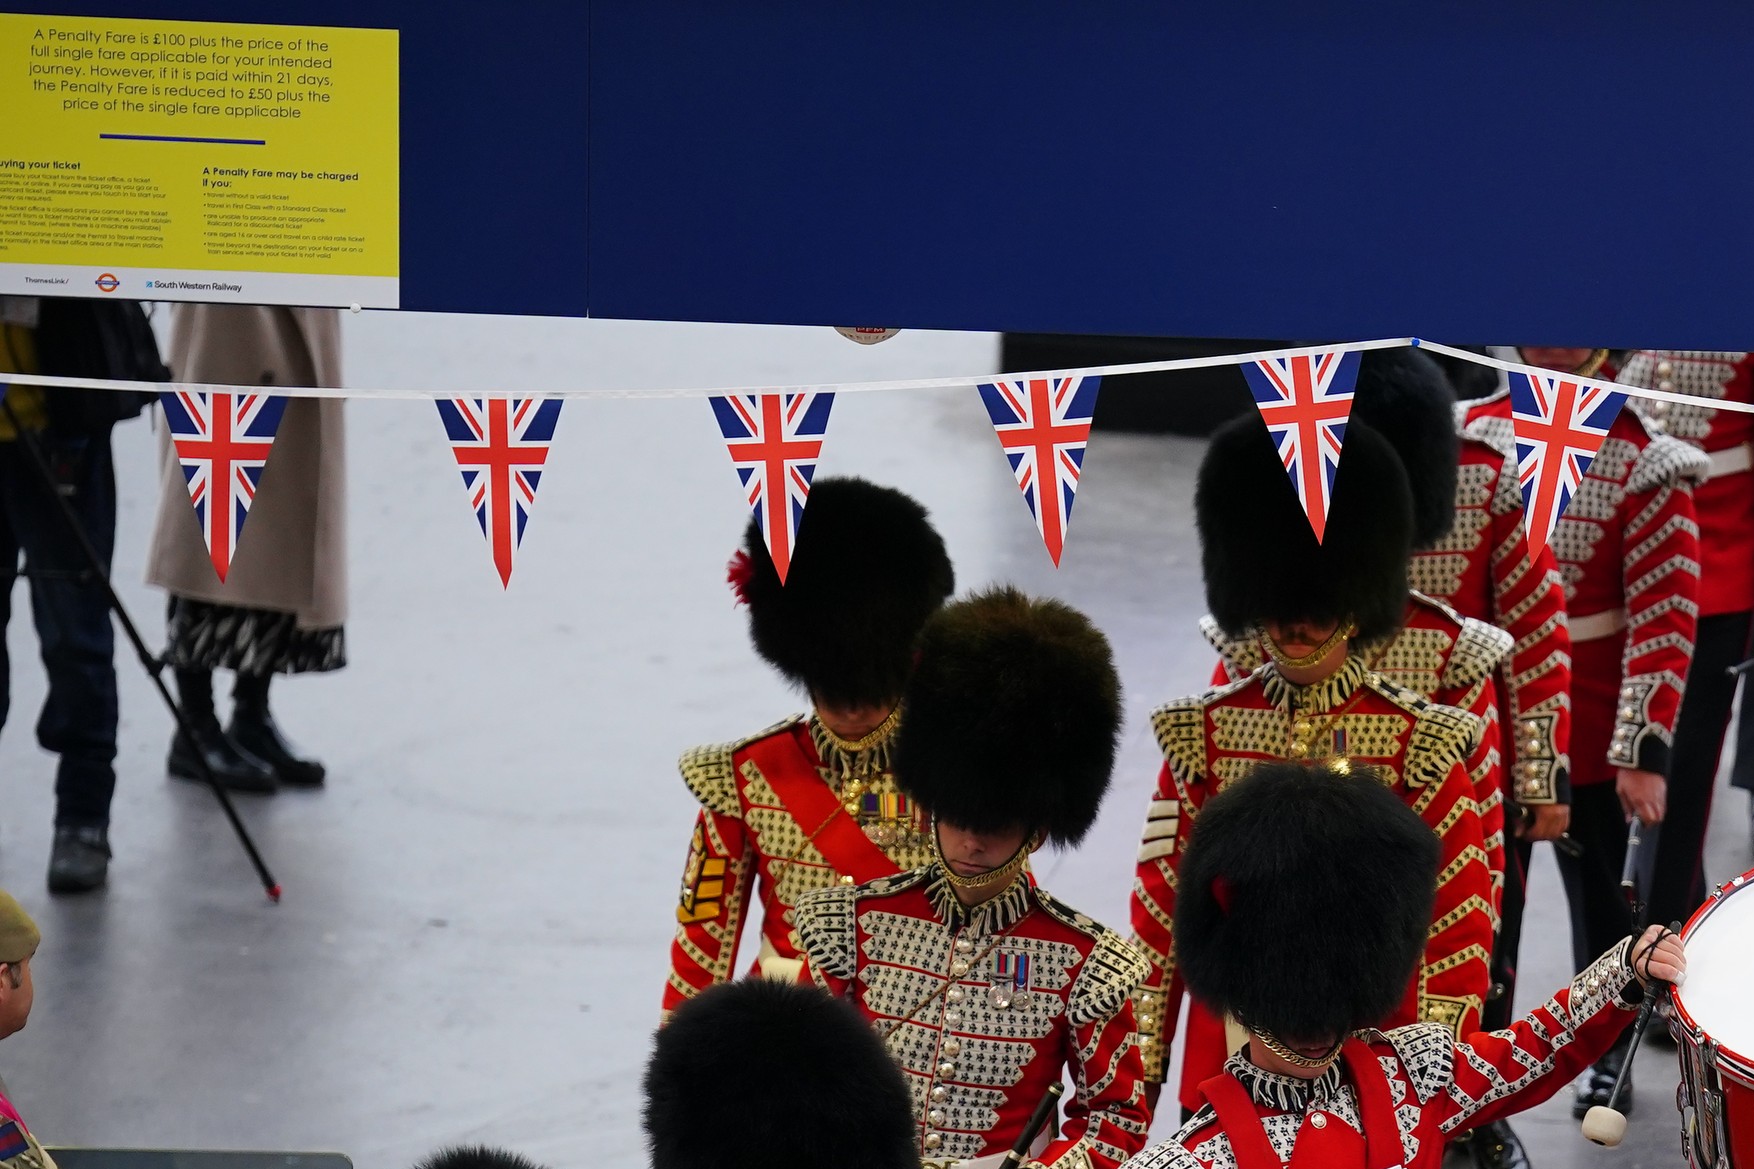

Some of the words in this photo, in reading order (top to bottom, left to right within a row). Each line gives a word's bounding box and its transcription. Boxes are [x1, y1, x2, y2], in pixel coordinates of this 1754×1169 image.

[33, 28, 45, 41] A
[50, 29, 101, 46] Penalty
[106, 31, 136, 44] Fare
[140, 32, 149, 45] is
[152, 33, 186, 46] £100
[189, 34, 217, 50] plus
[221, 36, 243, 48] the
[248, 37, 284, 53] price
[288, 38, 302, 51] of
[306, 39, 328, 52] the
[30, 45, 50, 58] full
[54, 46, 93, 62] single
[98, 48, 126, 60] fare
[130, 49, 207, 67] applicable
[211, 52, 229, 64] for
[233, 56, 264, 69] your
[268, 54, 332, 69] intended
[28, 62, 86, 79] journey.
[90, 64, 156, 80] However,
[159, 67, 168, 79] if
[171, 68, 179, 80] it
[183, 68, 192, 80] is
[195, 68, 228, 84] paid
[232, 70, 273, 83] within
[277, 72, 290, 84] 21
[296, 72, 333, 88] days,
[33, 79, 56, 92] the
[60, 80, 113, 97] Penalty
[117, 82, 148, 95] Fare
[152, 84, 161, 96] is
[164, 84, 226, 98] reduced
[230, 87, 244, 99] to
[248, 88, 272, 100] £50
[276, 89, 304, 104] plus
[308, 90, 330, 102] the
[63, 98, 99, 114] price
[103, 99, 118, 111] of
[121, 100, 144, 112] the
[148, 101, 188, 117] single
[192, 103, 220, 115] fare
[224, 104, 301, 122] applicable
[28, 162, 50, 170] your
[53, 161, 81, 170] ticket
[213, 167, 249, 178] Penalty
[252, 169, 273, 177] Fare
[276, 171, 298, 180] may
[301, 171, 314, 179] be
[317, 171, 359, 183] charged
[211, 181, 232, 189] you:
[154, 281, 177, 289] South
[178, 282, 211, 290] Western
[212, 283, 242, 292] Railway
